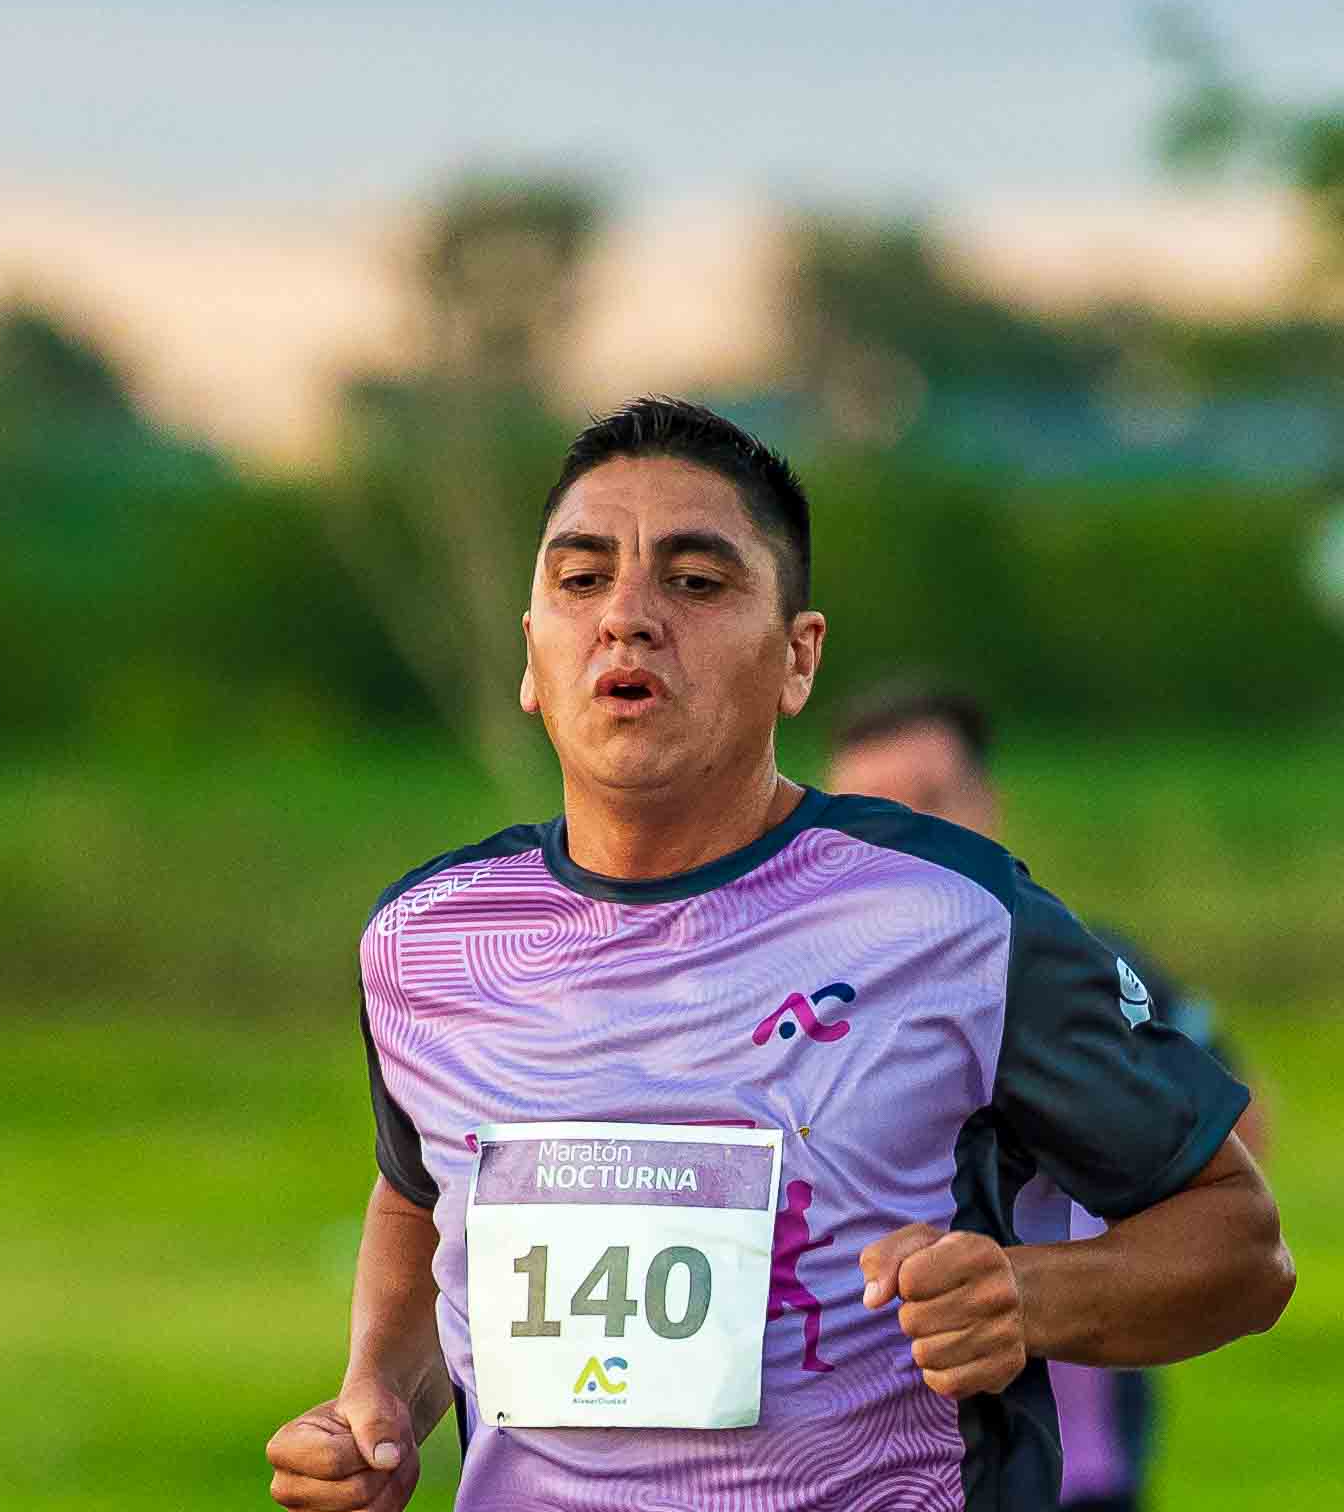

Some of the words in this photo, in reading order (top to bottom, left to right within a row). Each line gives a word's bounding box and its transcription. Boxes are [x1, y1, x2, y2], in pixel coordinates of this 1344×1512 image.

[538, 1139, 632, 1162] Maratón
[536, 1166, 698, 1192] NOCTURNA
[511, 1245, 712, 1339] 140
